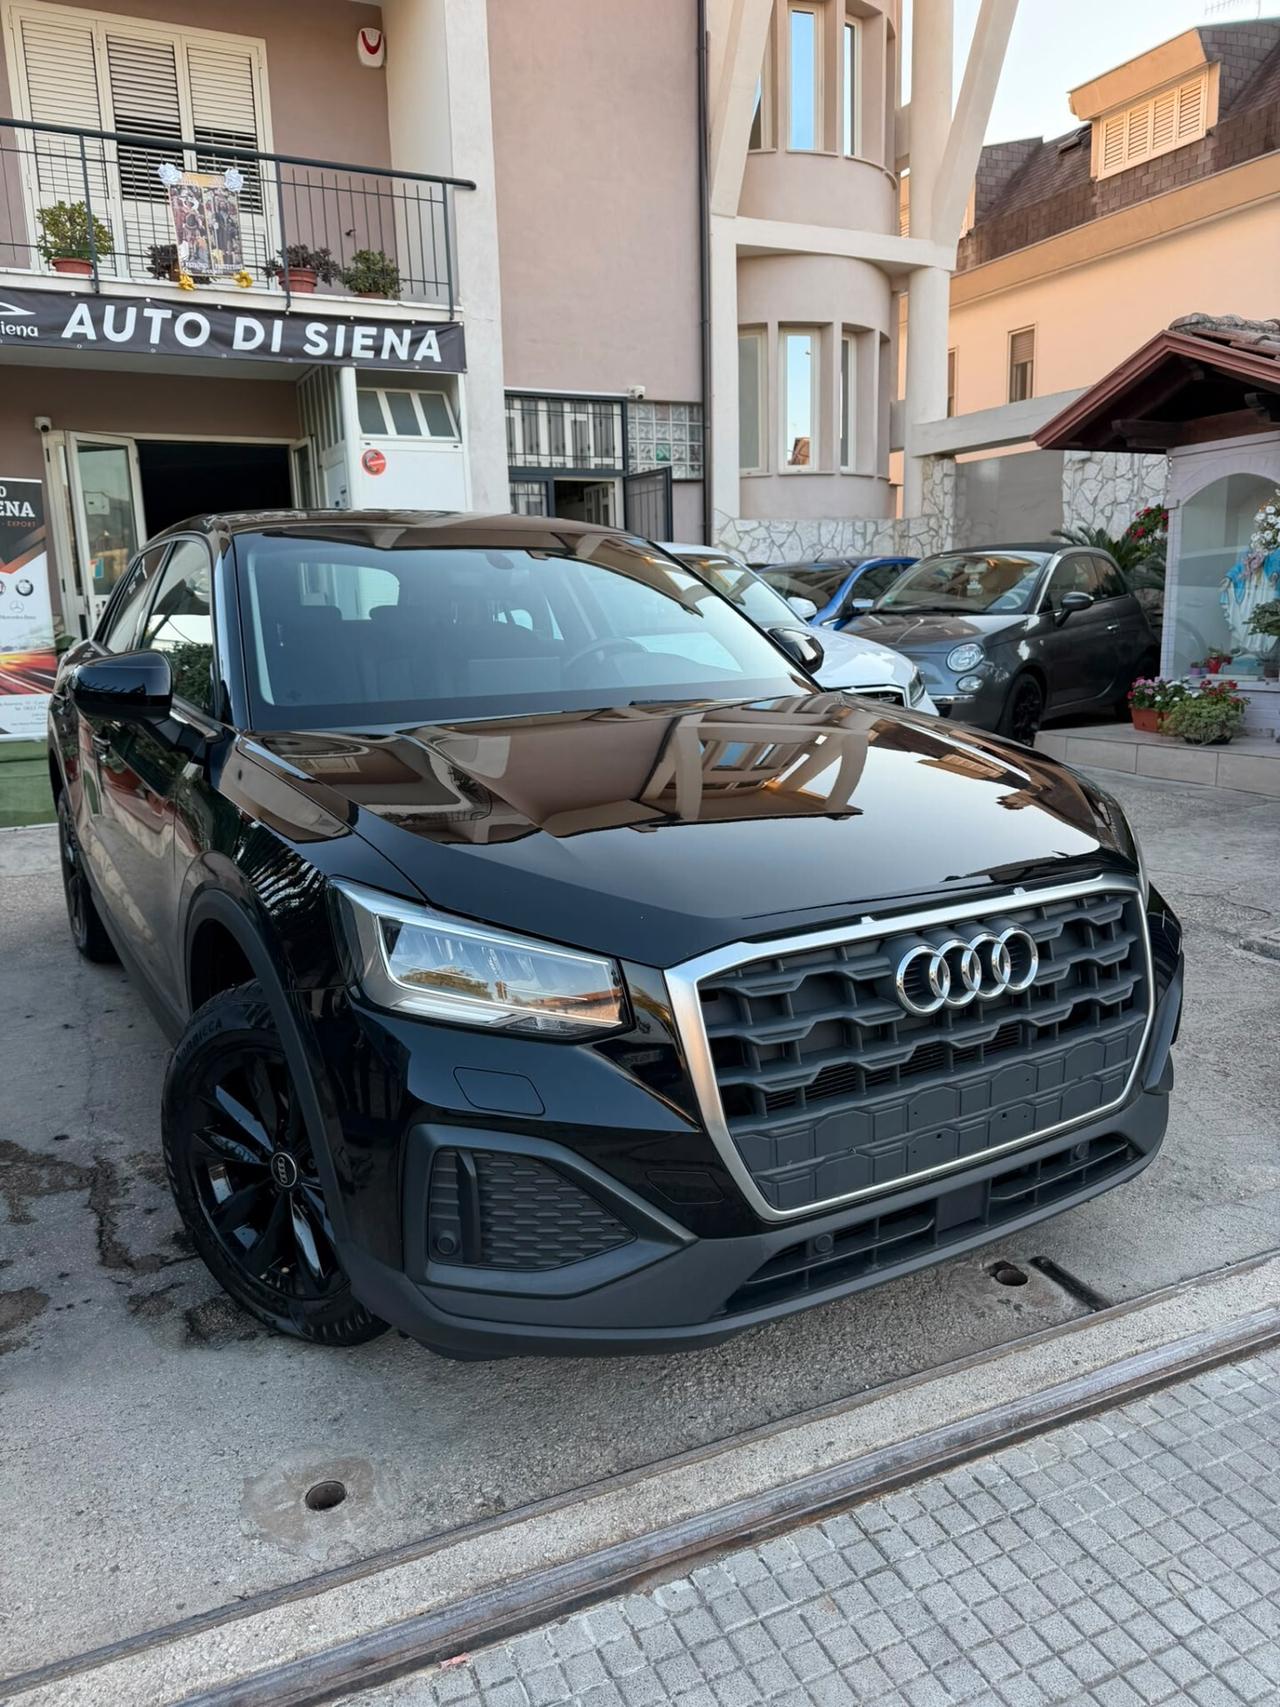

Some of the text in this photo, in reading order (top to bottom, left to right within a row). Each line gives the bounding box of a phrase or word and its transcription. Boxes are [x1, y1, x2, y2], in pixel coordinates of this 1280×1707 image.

[0, 320, 39, 338] iena
[61, 303, 442, 363] AUTO DI SIENA
